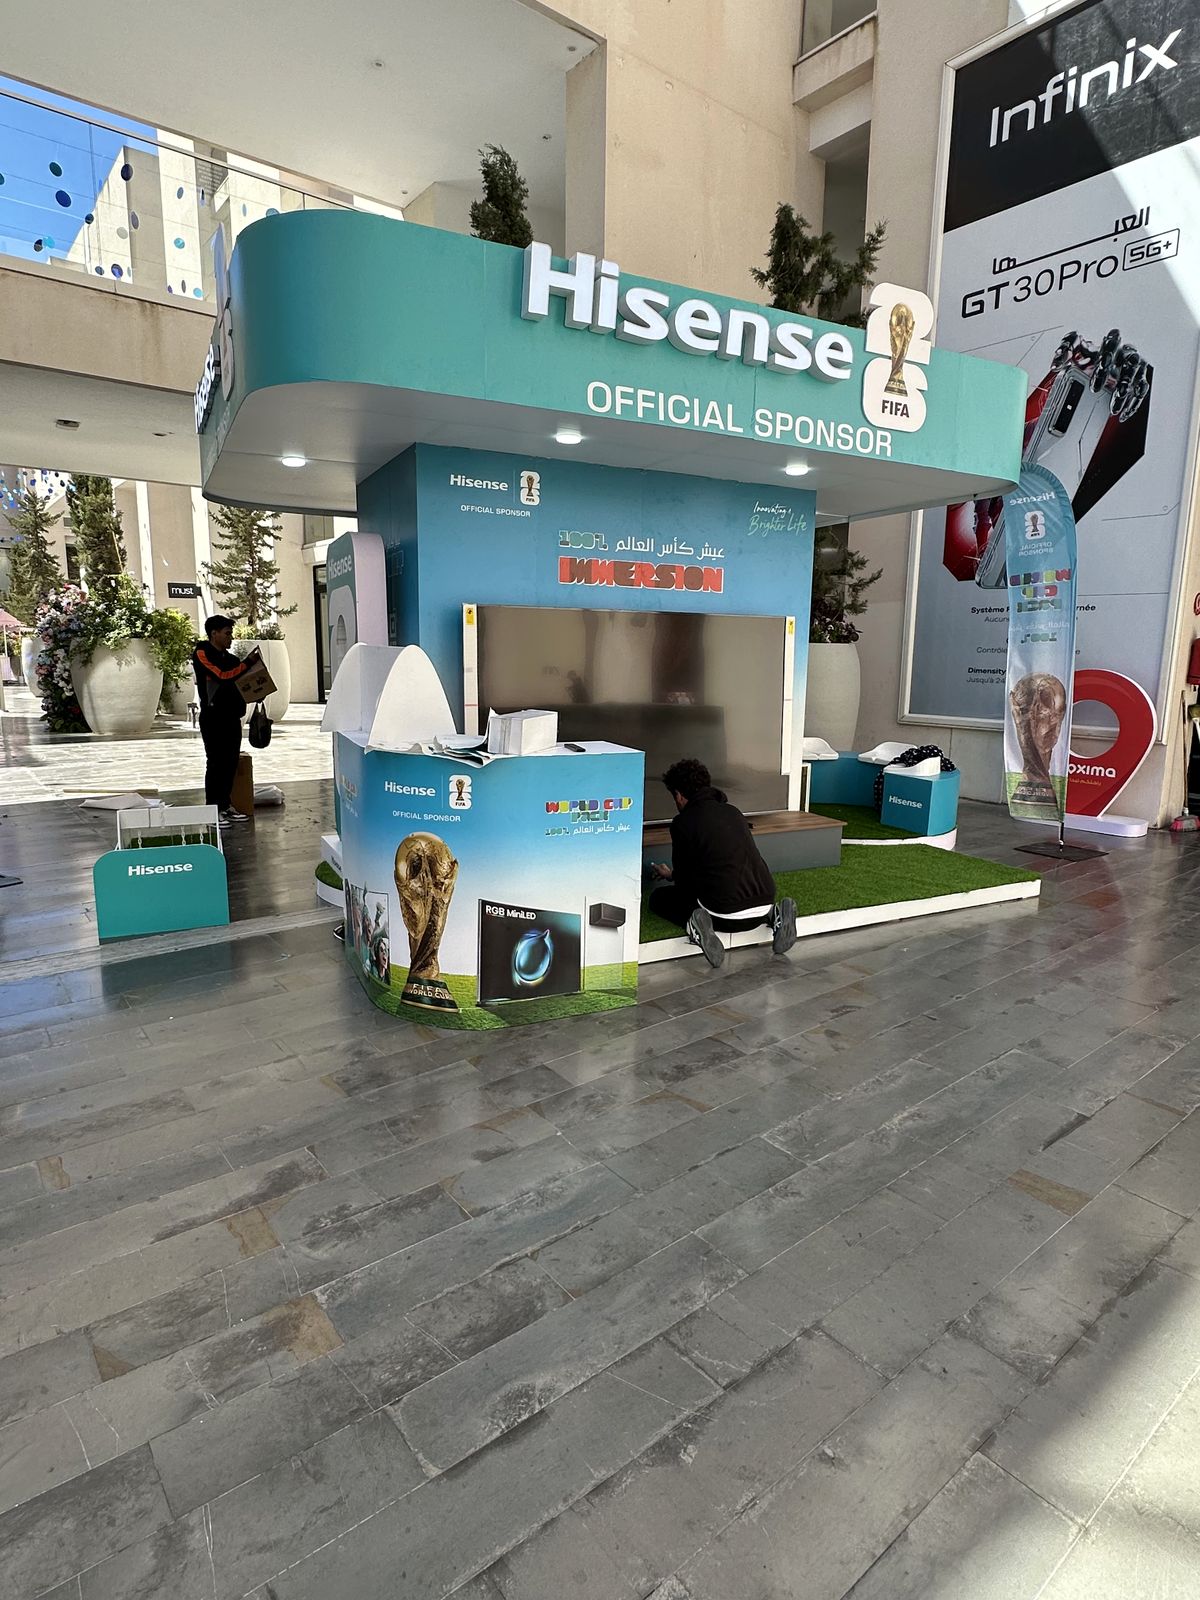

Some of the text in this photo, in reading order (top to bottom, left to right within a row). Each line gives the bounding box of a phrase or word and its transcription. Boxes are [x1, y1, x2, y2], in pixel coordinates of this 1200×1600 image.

[989, 29, 1182, 148] Infinix
[522, 241, 853, 383] Hisense
[881, 399, 910, 419] FIFA
[587, 381, 892, 457] OFFICIAL SPONSOR
[450, 474, 508, 491] Hisense
[461, 504, 531, 517] OFFICIAL SPONSOR
[747, 513, 808, 537] Brighter Life
[615, 536, 654, 553] العالم
[657, 537, 694, 557] كأس
[697, 542, 725, 561] عيش
[328, 554, 353, 581] Hisense
[558, 555, 724, 593] IMMERSION
[171, 586, 194, 595] must
[971, 606, 1005, 615] Système
[967, 667, 1006, 676] Dimensity
[384, 781, 436, 797] Hisense
[888, 795, 923, 809] Hisense
[392, 810, 461, 822] OFFICIAL SPONSOR
[572, 825, 594, 836] العالم
[128, 862, 193, 877] Hisense
[485, 904, 537, 920] RGB MiniLED
